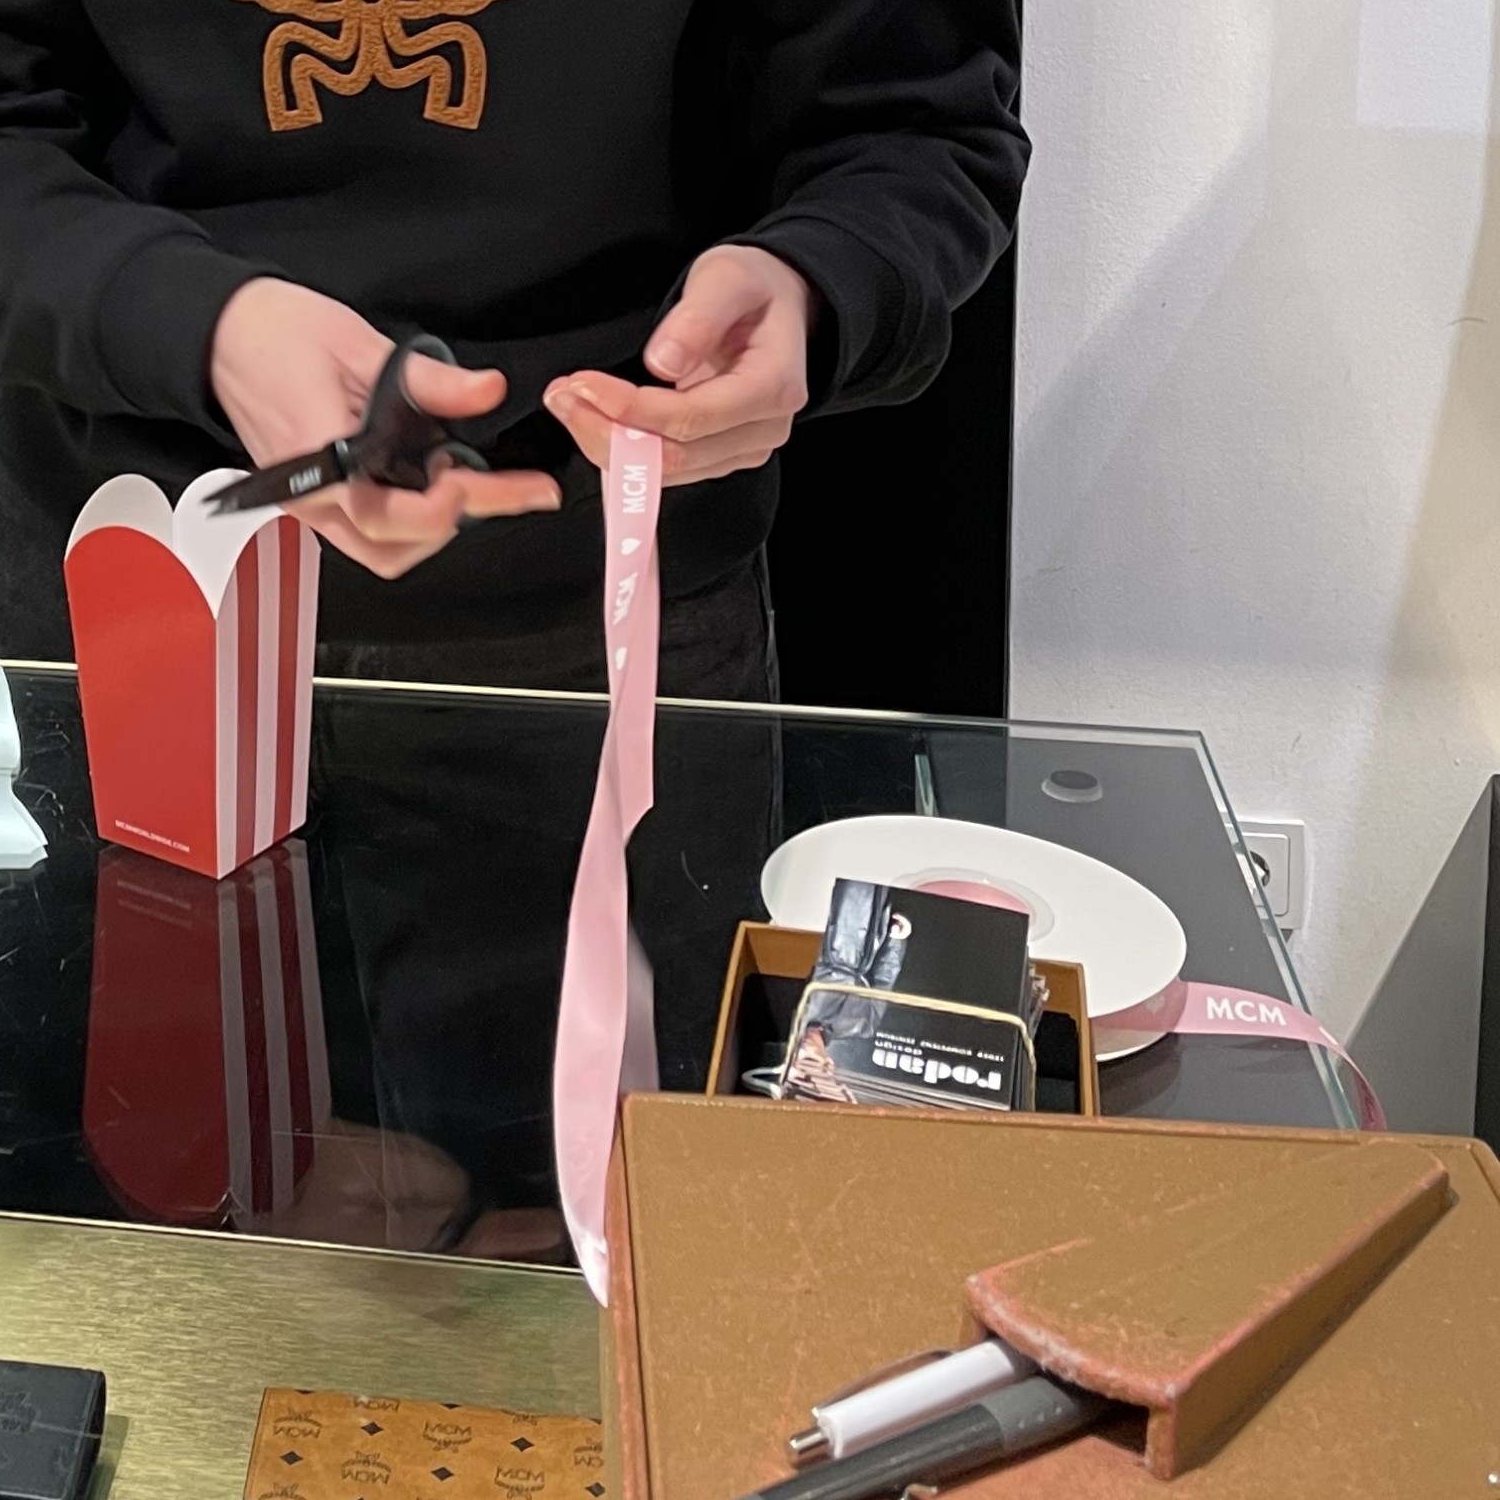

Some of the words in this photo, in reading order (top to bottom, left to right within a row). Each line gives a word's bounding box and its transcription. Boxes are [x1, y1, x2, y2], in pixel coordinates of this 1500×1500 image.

[621, 465, 648, 515] MCM
[1206, 996, 1288, 1027] MCM
[871, 1048, 1002, 1091] rodan
[273, 1423, 321, 1440] MCM
[424, 1418, 472, 1436] MCM
[341, 1467, 390, 1485] MCM
[495, 1463, 545, 1483] MCM
